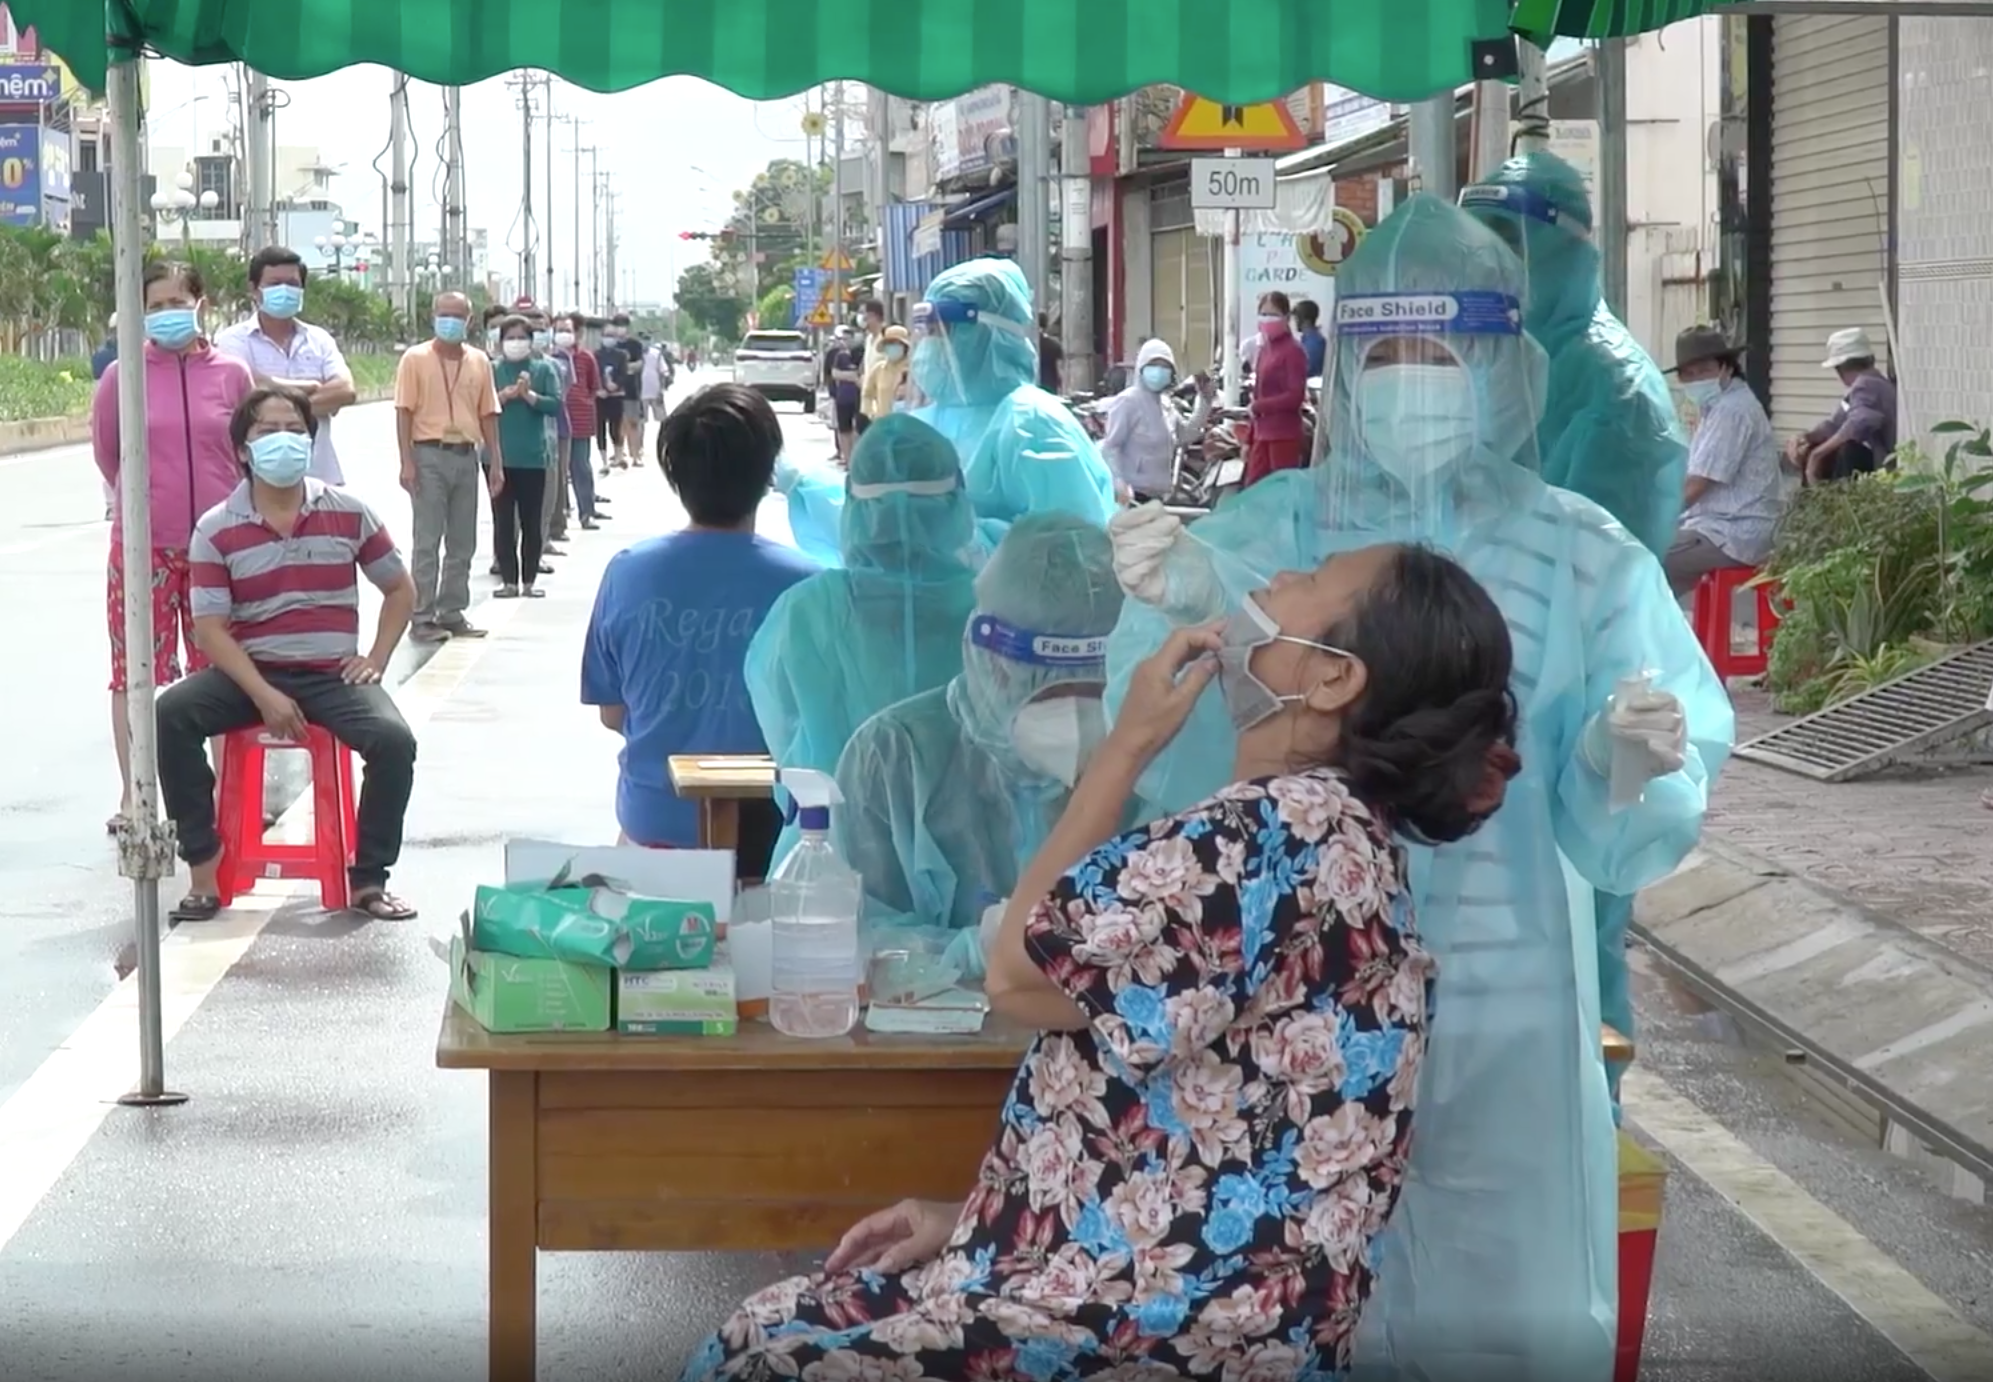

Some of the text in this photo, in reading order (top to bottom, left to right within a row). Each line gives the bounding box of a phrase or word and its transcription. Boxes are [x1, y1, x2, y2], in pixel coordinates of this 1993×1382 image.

[1208, 170, 1260, 196] 50m
[1340, 304, 1374, 320] Face
[1381, 301, 1447, 317] Shield
[1041, 640, 1080, 654] Face
[656, 667, 750, 712] 201
